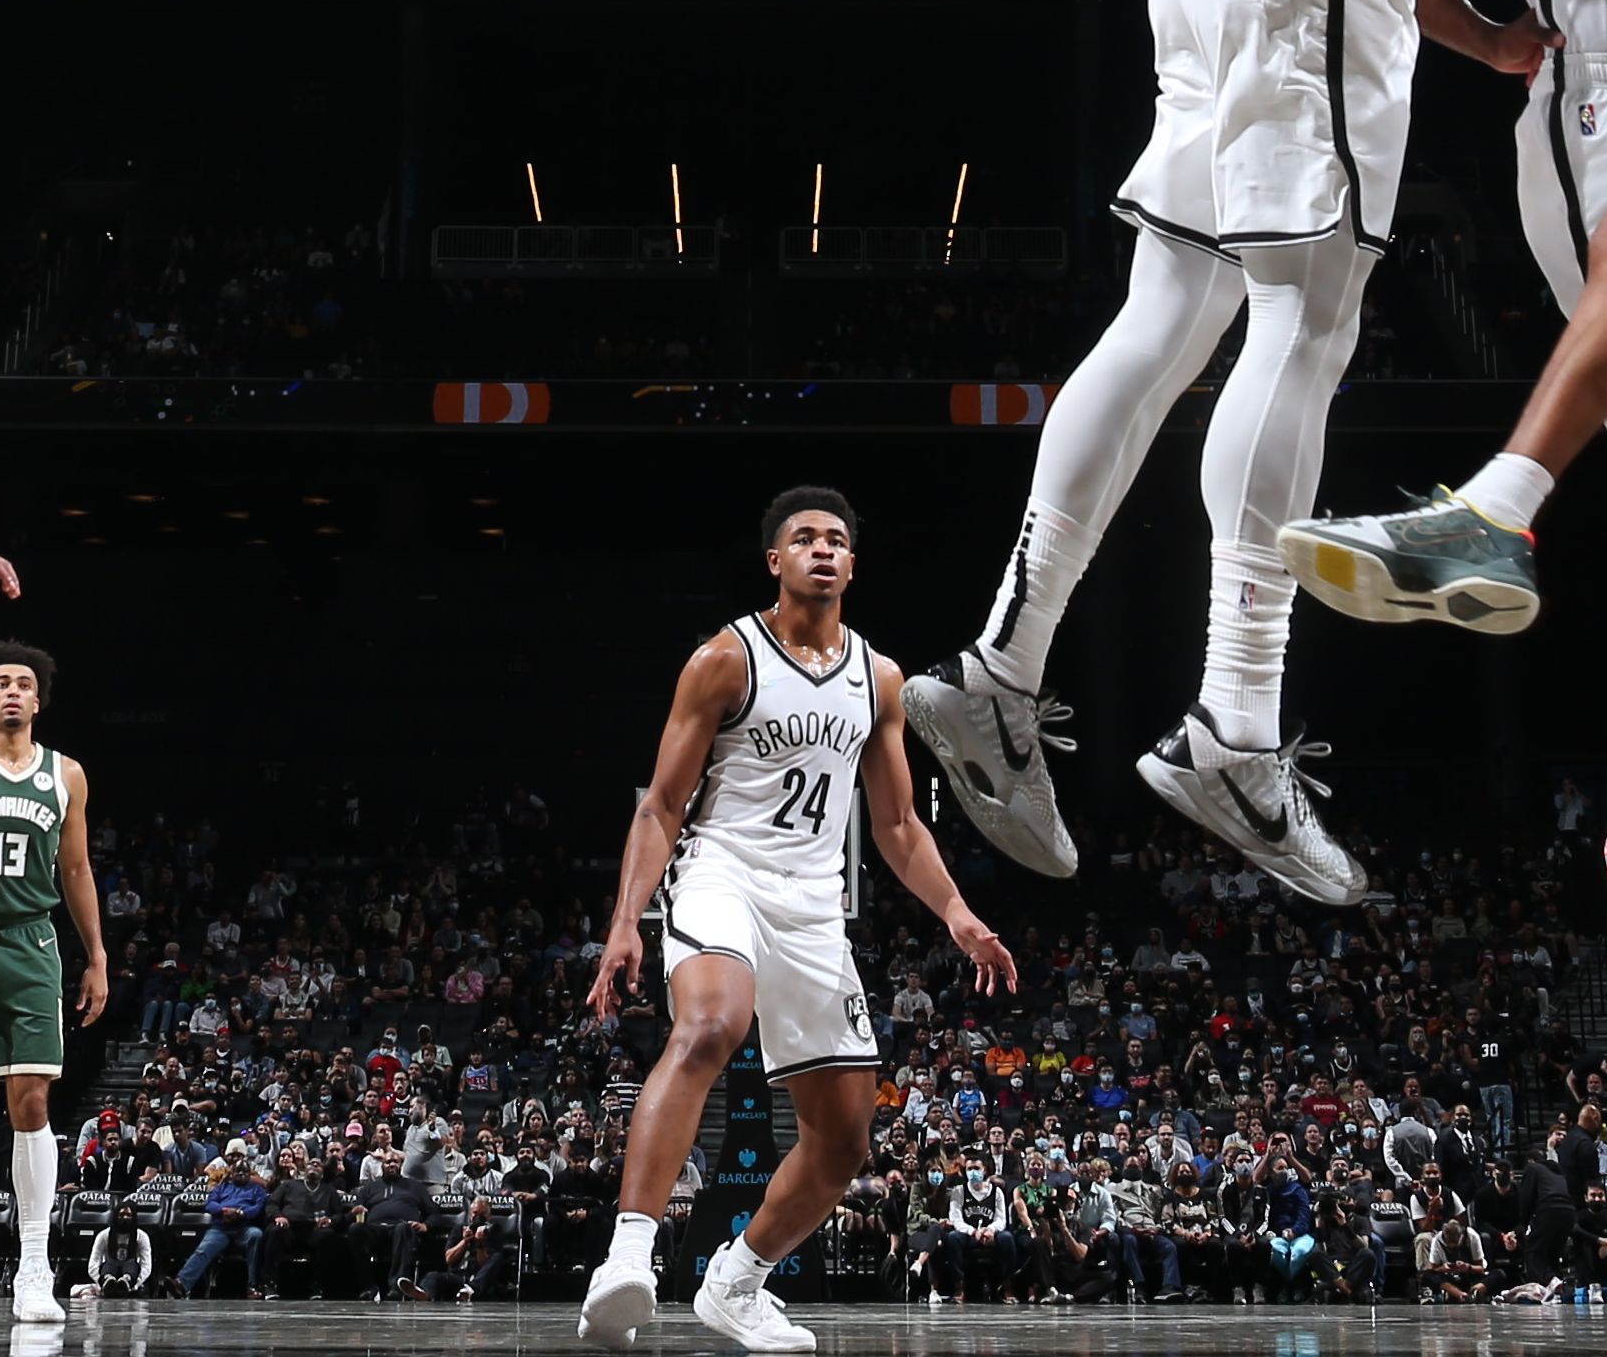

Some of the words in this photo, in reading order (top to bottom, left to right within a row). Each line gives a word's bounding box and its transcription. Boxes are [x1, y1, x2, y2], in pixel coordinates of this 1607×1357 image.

[748, 713, 867, 770] BROOKLYN
[773, 767, 832, 835] 24
[1481, 1043, 1499, 1058] 30
[718, 1173, 773, 1185] BARCLAY
[80, 1193, 112, 1202] QATAR
[130, 1193, 161, 1202] QATAR
[432, 1195, 464, 1205] QATAR
[1371, 1202, 1402, 1211] QATAR
